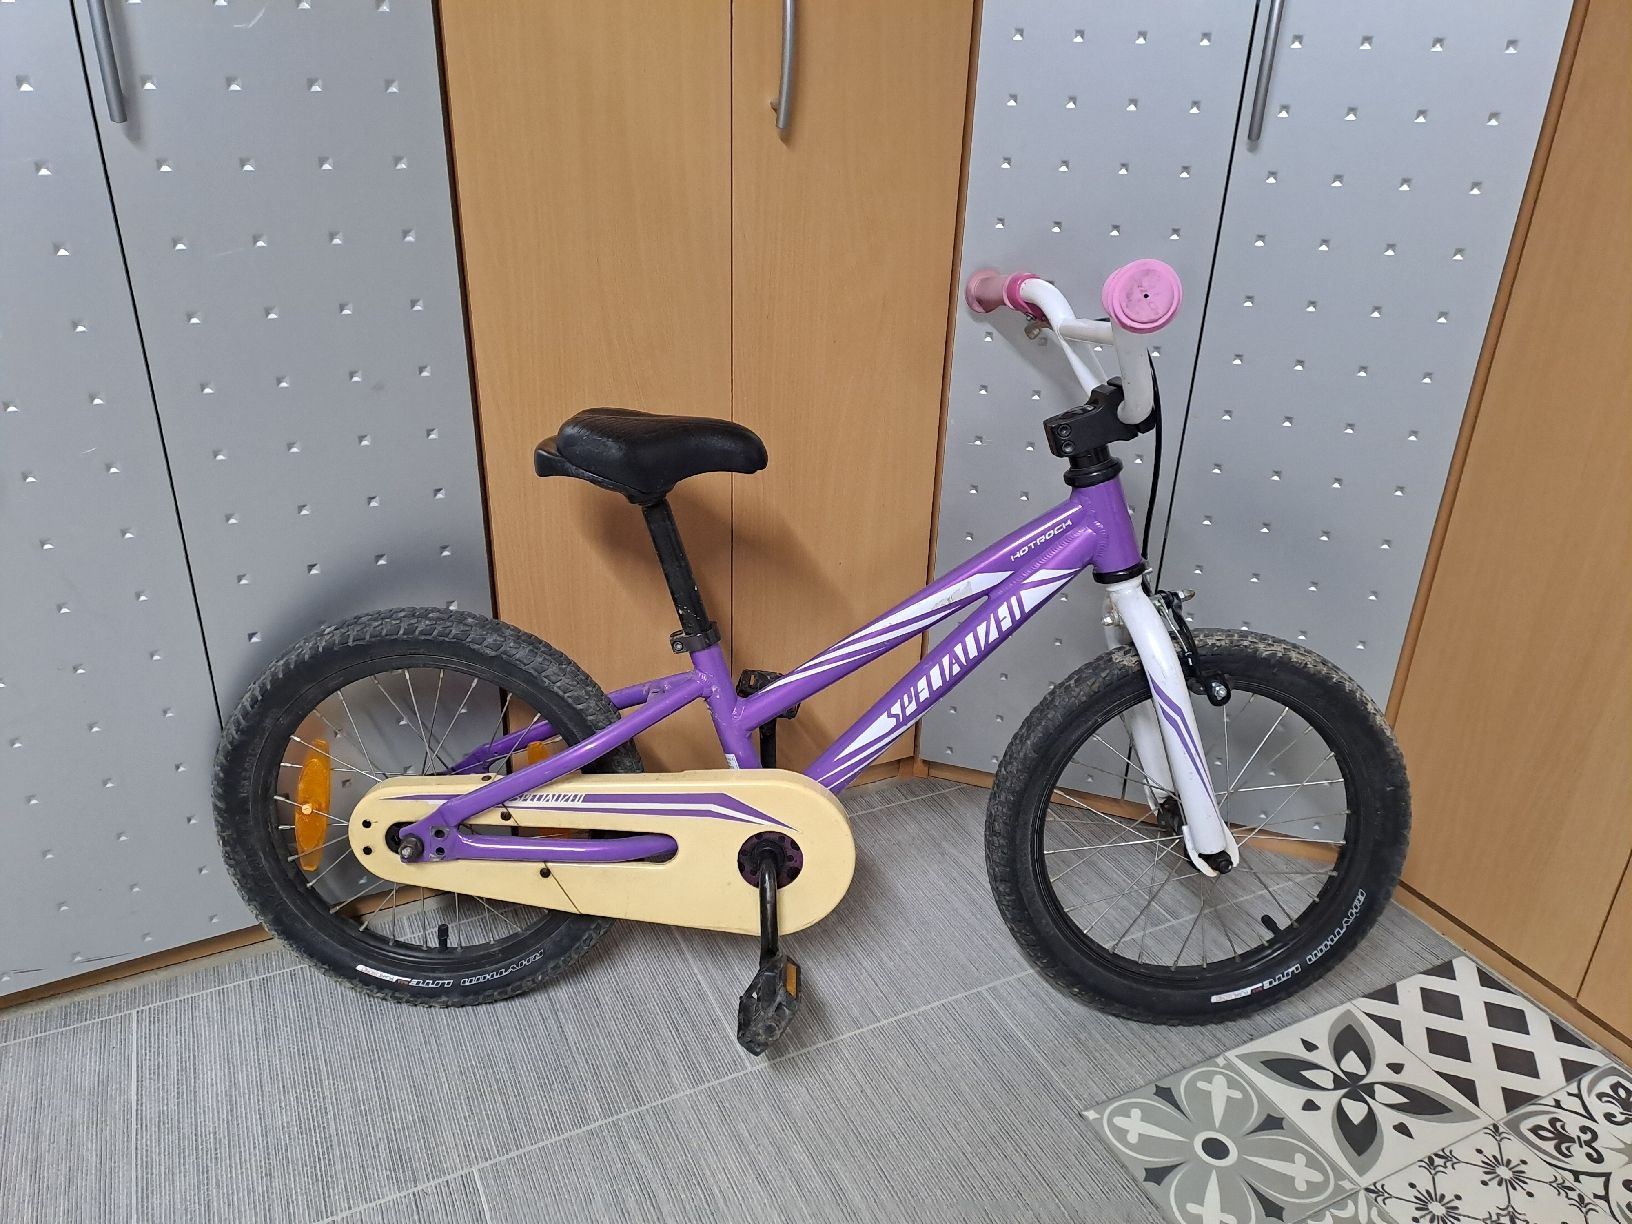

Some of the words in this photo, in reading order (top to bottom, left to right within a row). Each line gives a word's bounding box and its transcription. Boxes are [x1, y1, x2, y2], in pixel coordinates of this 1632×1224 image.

[1011, 519, 1073, 562] HOTROCK
[886, 589, 1028, 727] SPECIALIZED
[408, 978, 454, 988] LITE
[1263, 964, 1301, 990] LITE
